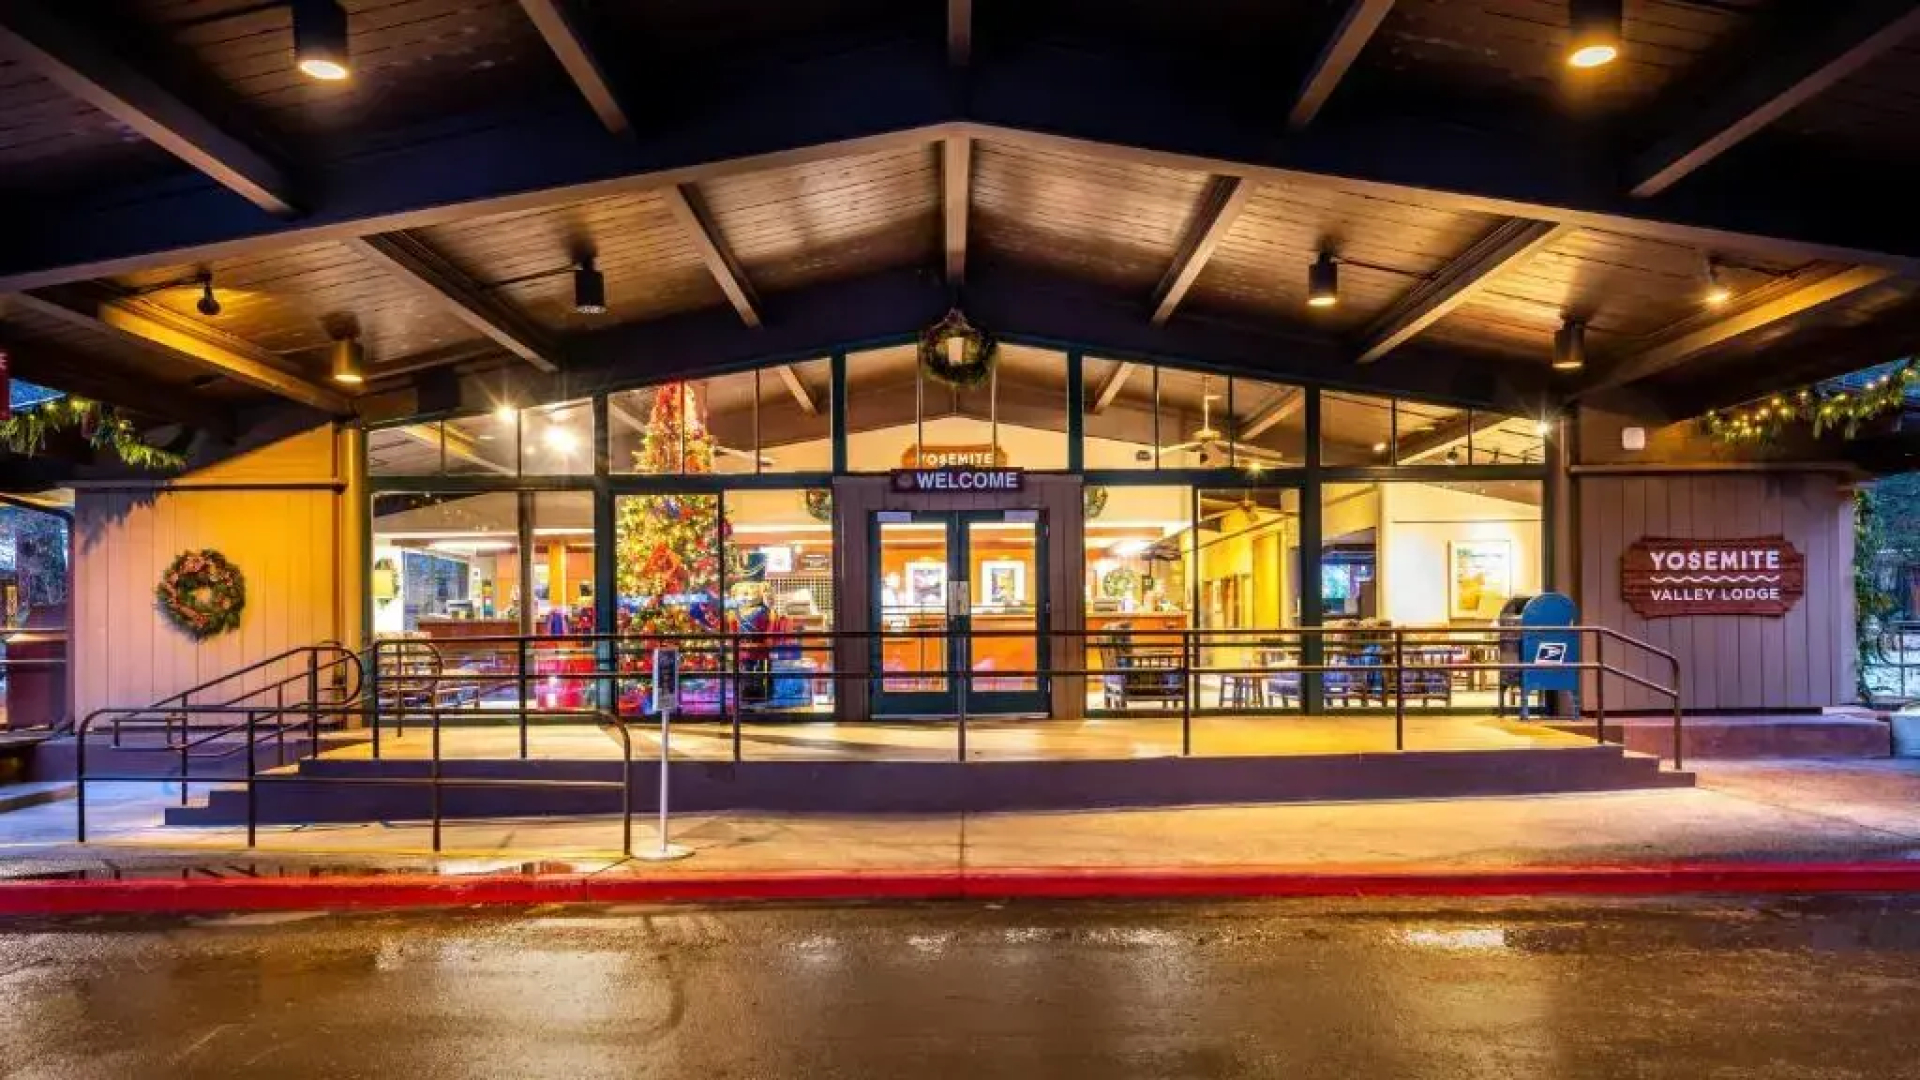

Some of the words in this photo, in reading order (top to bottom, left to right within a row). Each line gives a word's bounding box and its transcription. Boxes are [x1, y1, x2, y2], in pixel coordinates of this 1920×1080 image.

[916, 472, 1018, 488] WELCOME
[1650, 550, 1780, 570] YOSEMITE
[1651, 588, 1715, 600] VALLEY
[1722, 588, 1780, 600] LODGE
